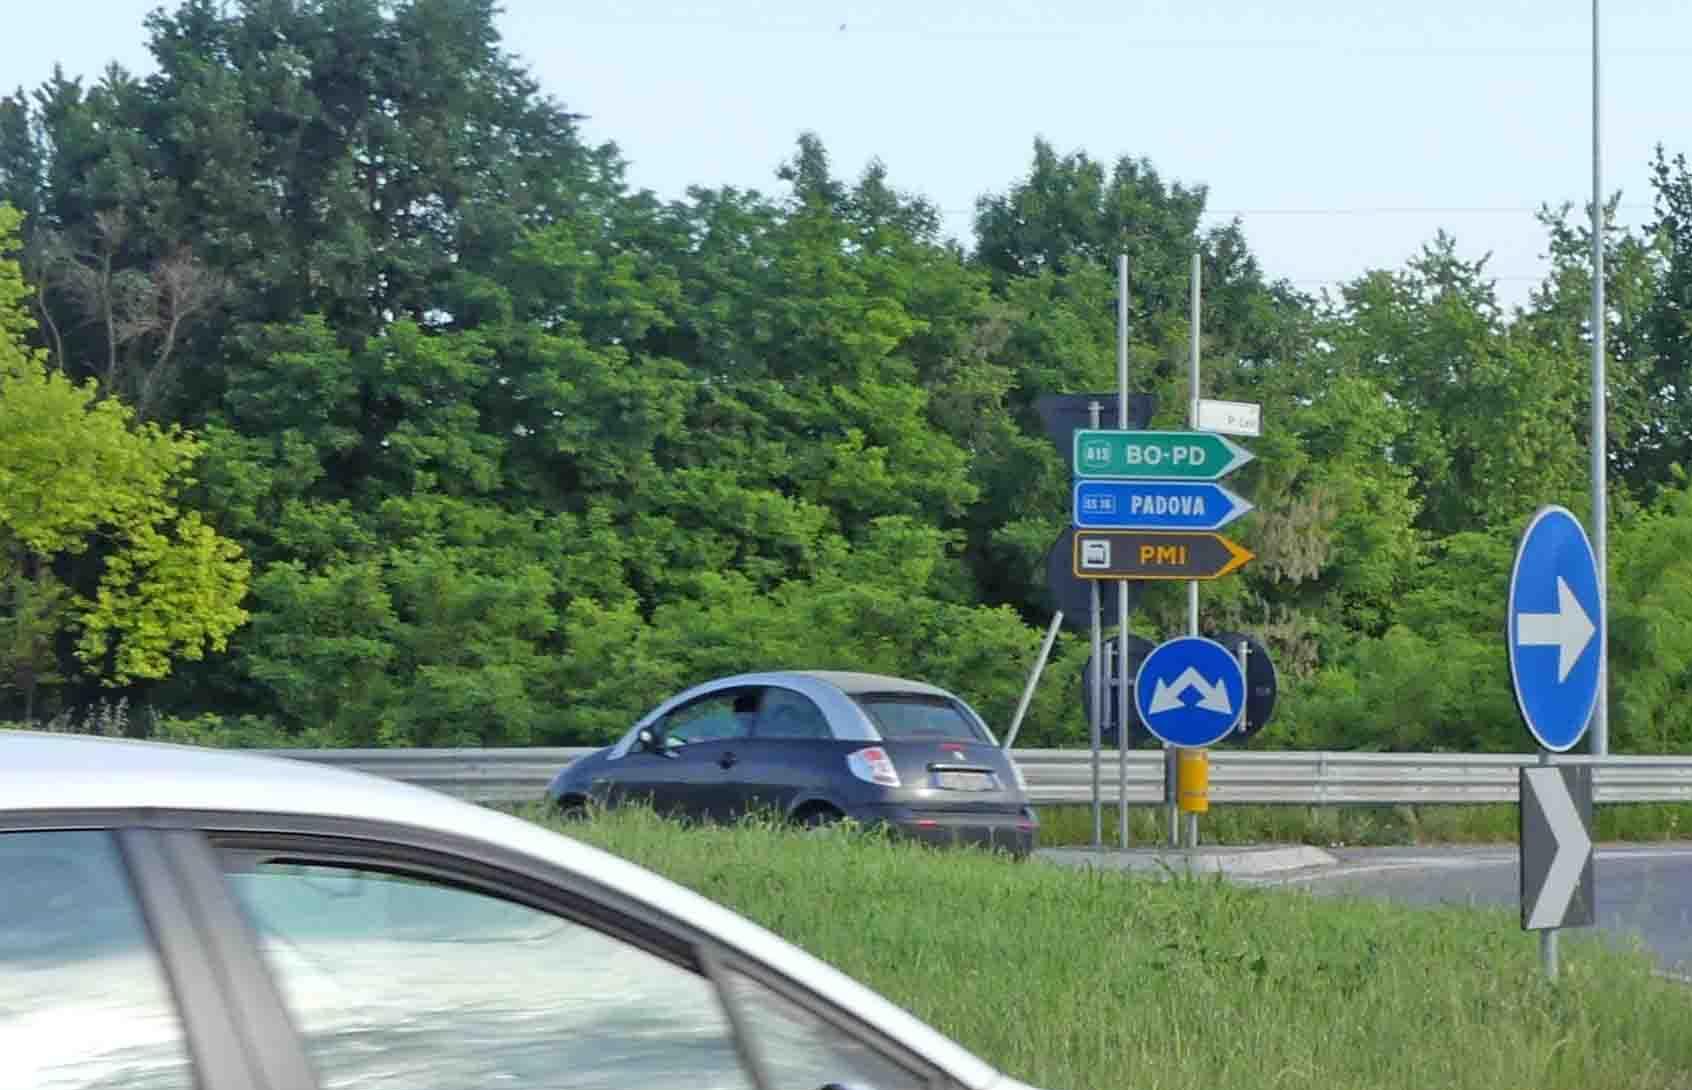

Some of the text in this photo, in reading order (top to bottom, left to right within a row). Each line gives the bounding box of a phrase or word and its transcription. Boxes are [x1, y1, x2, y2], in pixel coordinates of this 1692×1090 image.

[1126, 444, 1206, 465] BO-PD
[1131, 495, 1206, 516] PADOVA
[1140, 544, 1186, 565] PMI
